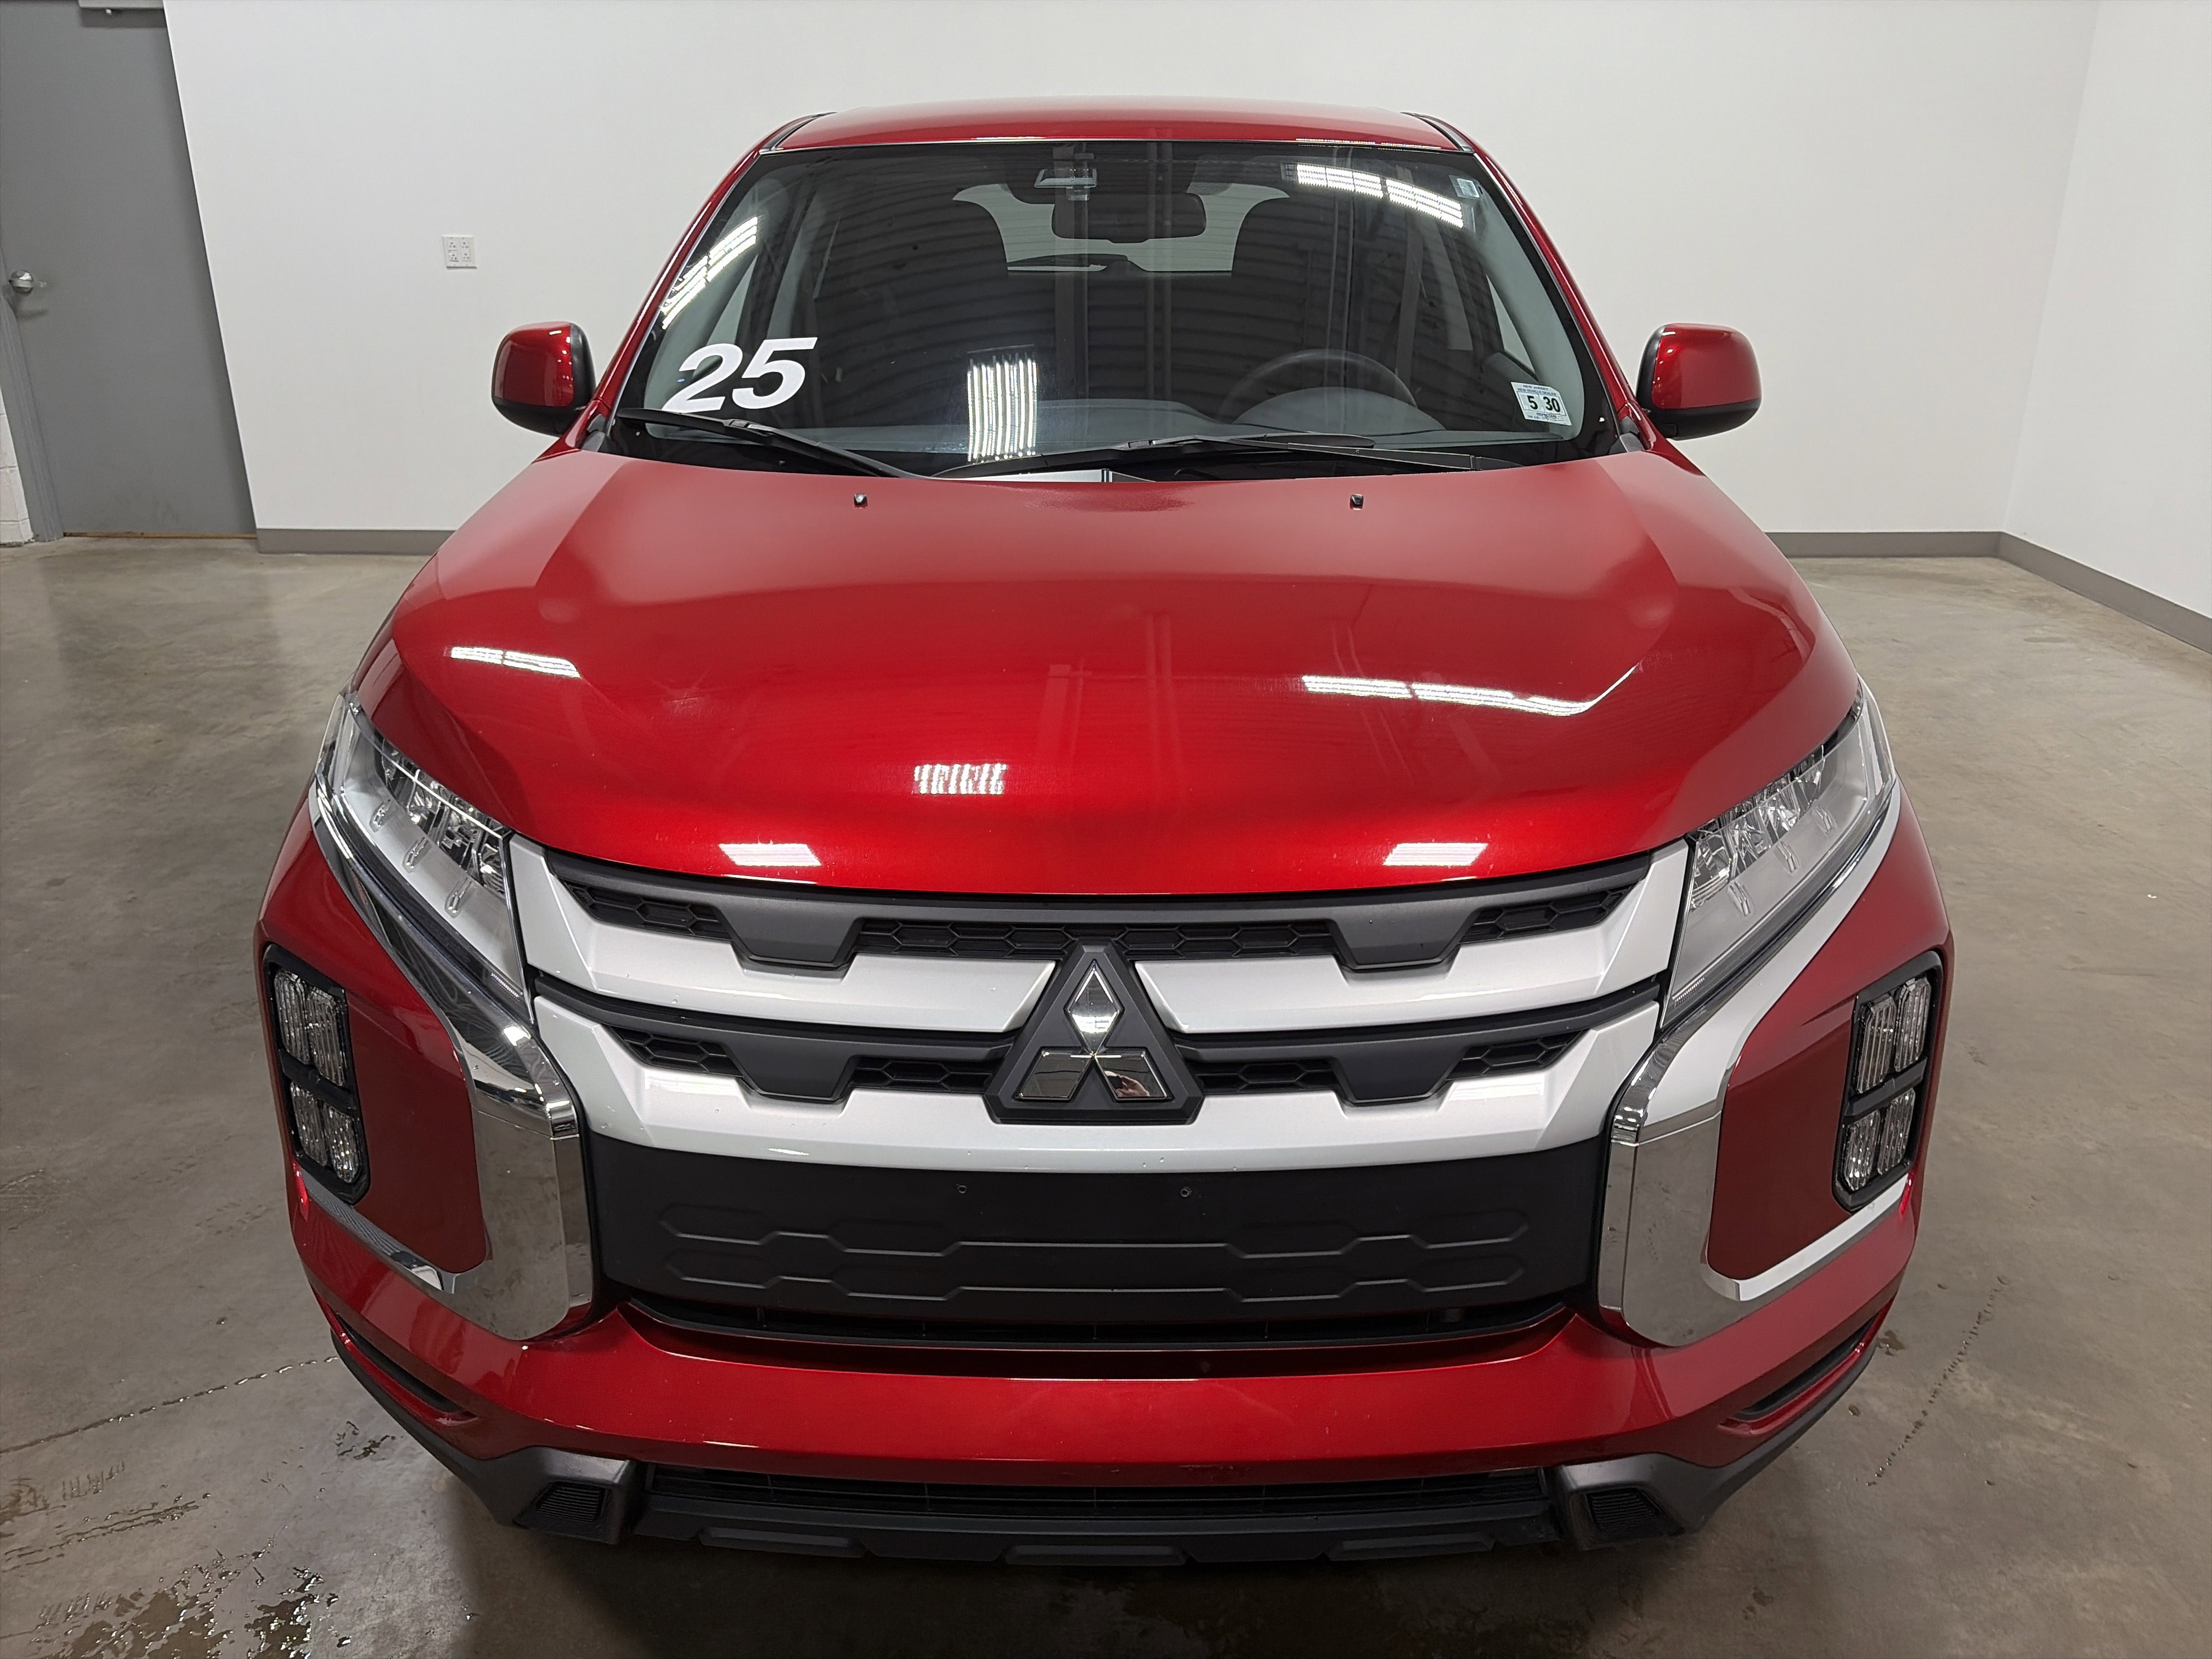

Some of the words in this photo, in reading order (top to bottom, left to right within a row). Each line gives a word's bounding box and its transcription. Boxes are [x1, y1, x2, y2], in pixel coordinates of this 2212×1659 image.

[661, 337, 818, 413] 25
[1526, 394, 1538, 410] 5
[1543, 396, 1561, 413] 30
